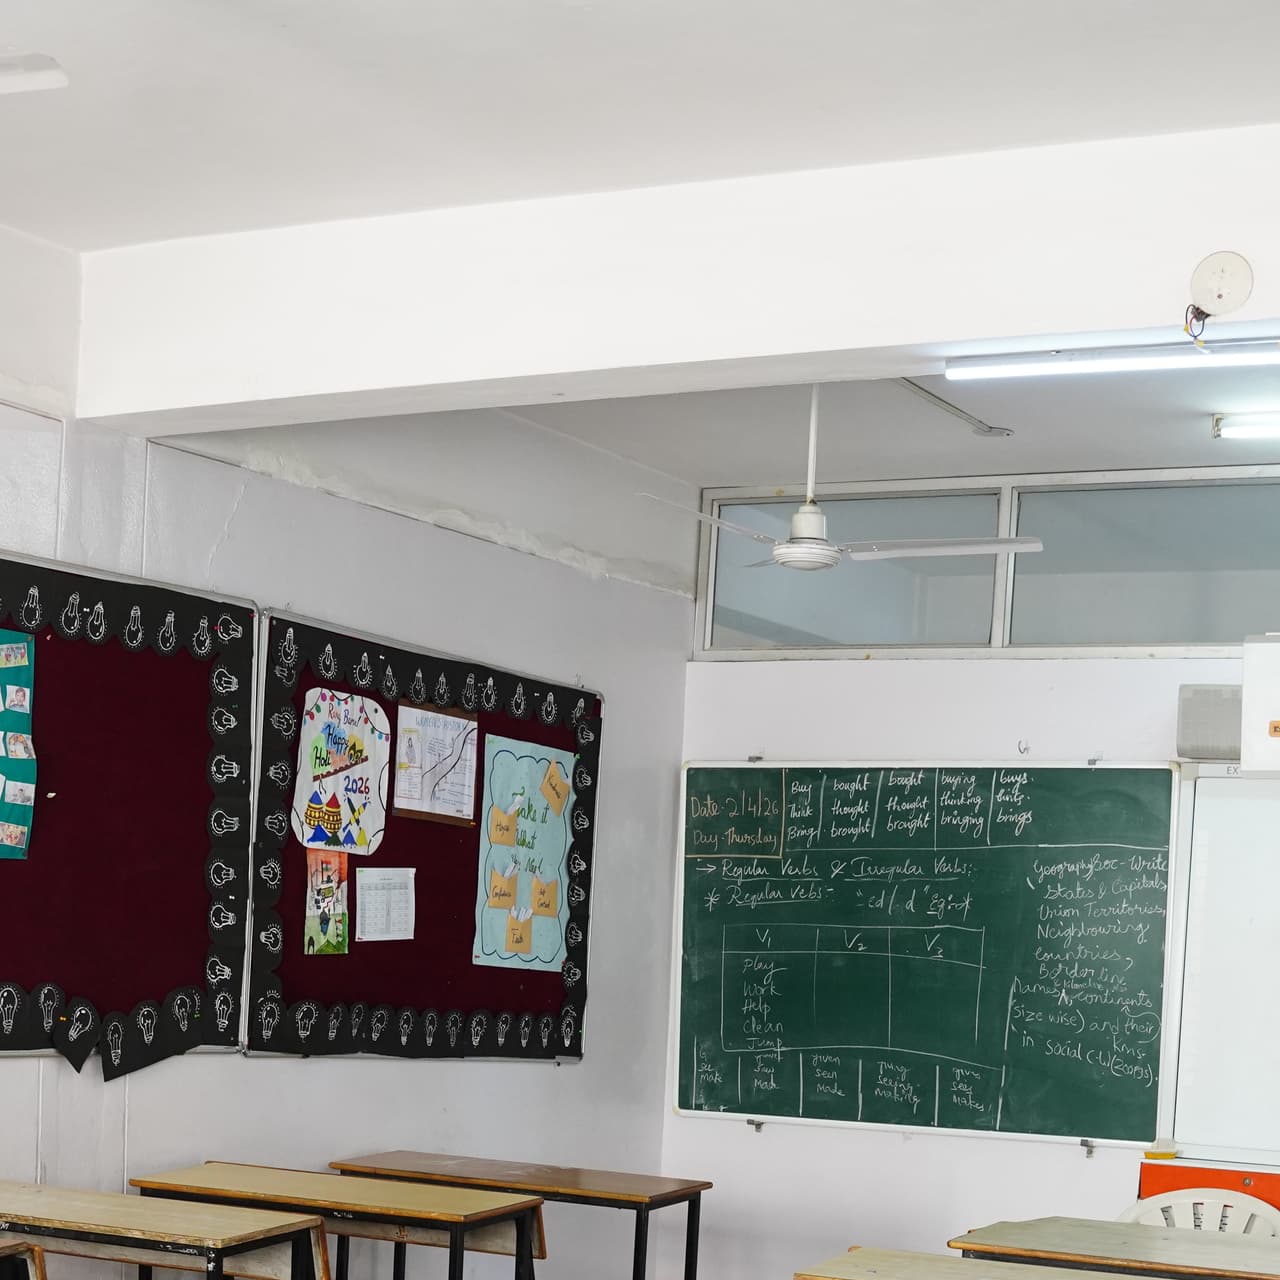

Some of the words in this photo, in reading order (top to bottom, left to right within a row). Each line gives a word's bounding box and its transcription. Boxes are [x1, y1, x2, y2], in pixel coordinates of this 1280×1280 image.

[324, 724, 349, 756] Happy
[314, 746, 332, 768] Holi
[344, 775, 370, 794] 2026
[791, 781, 813, 803] Buy
[832, 772, 870, 799] bought
[888, 770, 925, 795] bought
[941, 770, 976, 796] buying
[787, 802, 814, 819] Think
[831, 799, 870, 821] thought
[885, 796, 930, 818] thought
[940, 791, 983, 813] thinking
[540, 804, 550, 824] it
[886, 812, 930, 838] brought
[940, 810, 984, 838] bringing
[996, 808, 1034, 837] brings
[787, 826, 817, 848] Bring
[830, 818, 870, 843] brought
[722, 858, 770, 886] Regular
[781, 854, 819, 876] Verbs
[830, 860, 848, 879] &
[850, 856, 924, 884] Irregular
[1129, 853, 1168, 873] Write
[726, 881, 784, 909] Regular
[1038, 904, 1080, 920] Union
[742, 955, 788, 985] Play
[1039, 962, 1094, 980] Border
[743, 981, 782, 997] Work
[1012, 976, 1060, 997] Names
[742, 996, 771, 1022] Help
[743, 1016, 784, 1034] Clean
[1090, 1017, 1120, 1036] and
[1124, 1016, 1154, 1036] their
[1022, 1030, 1035, 1047] in
